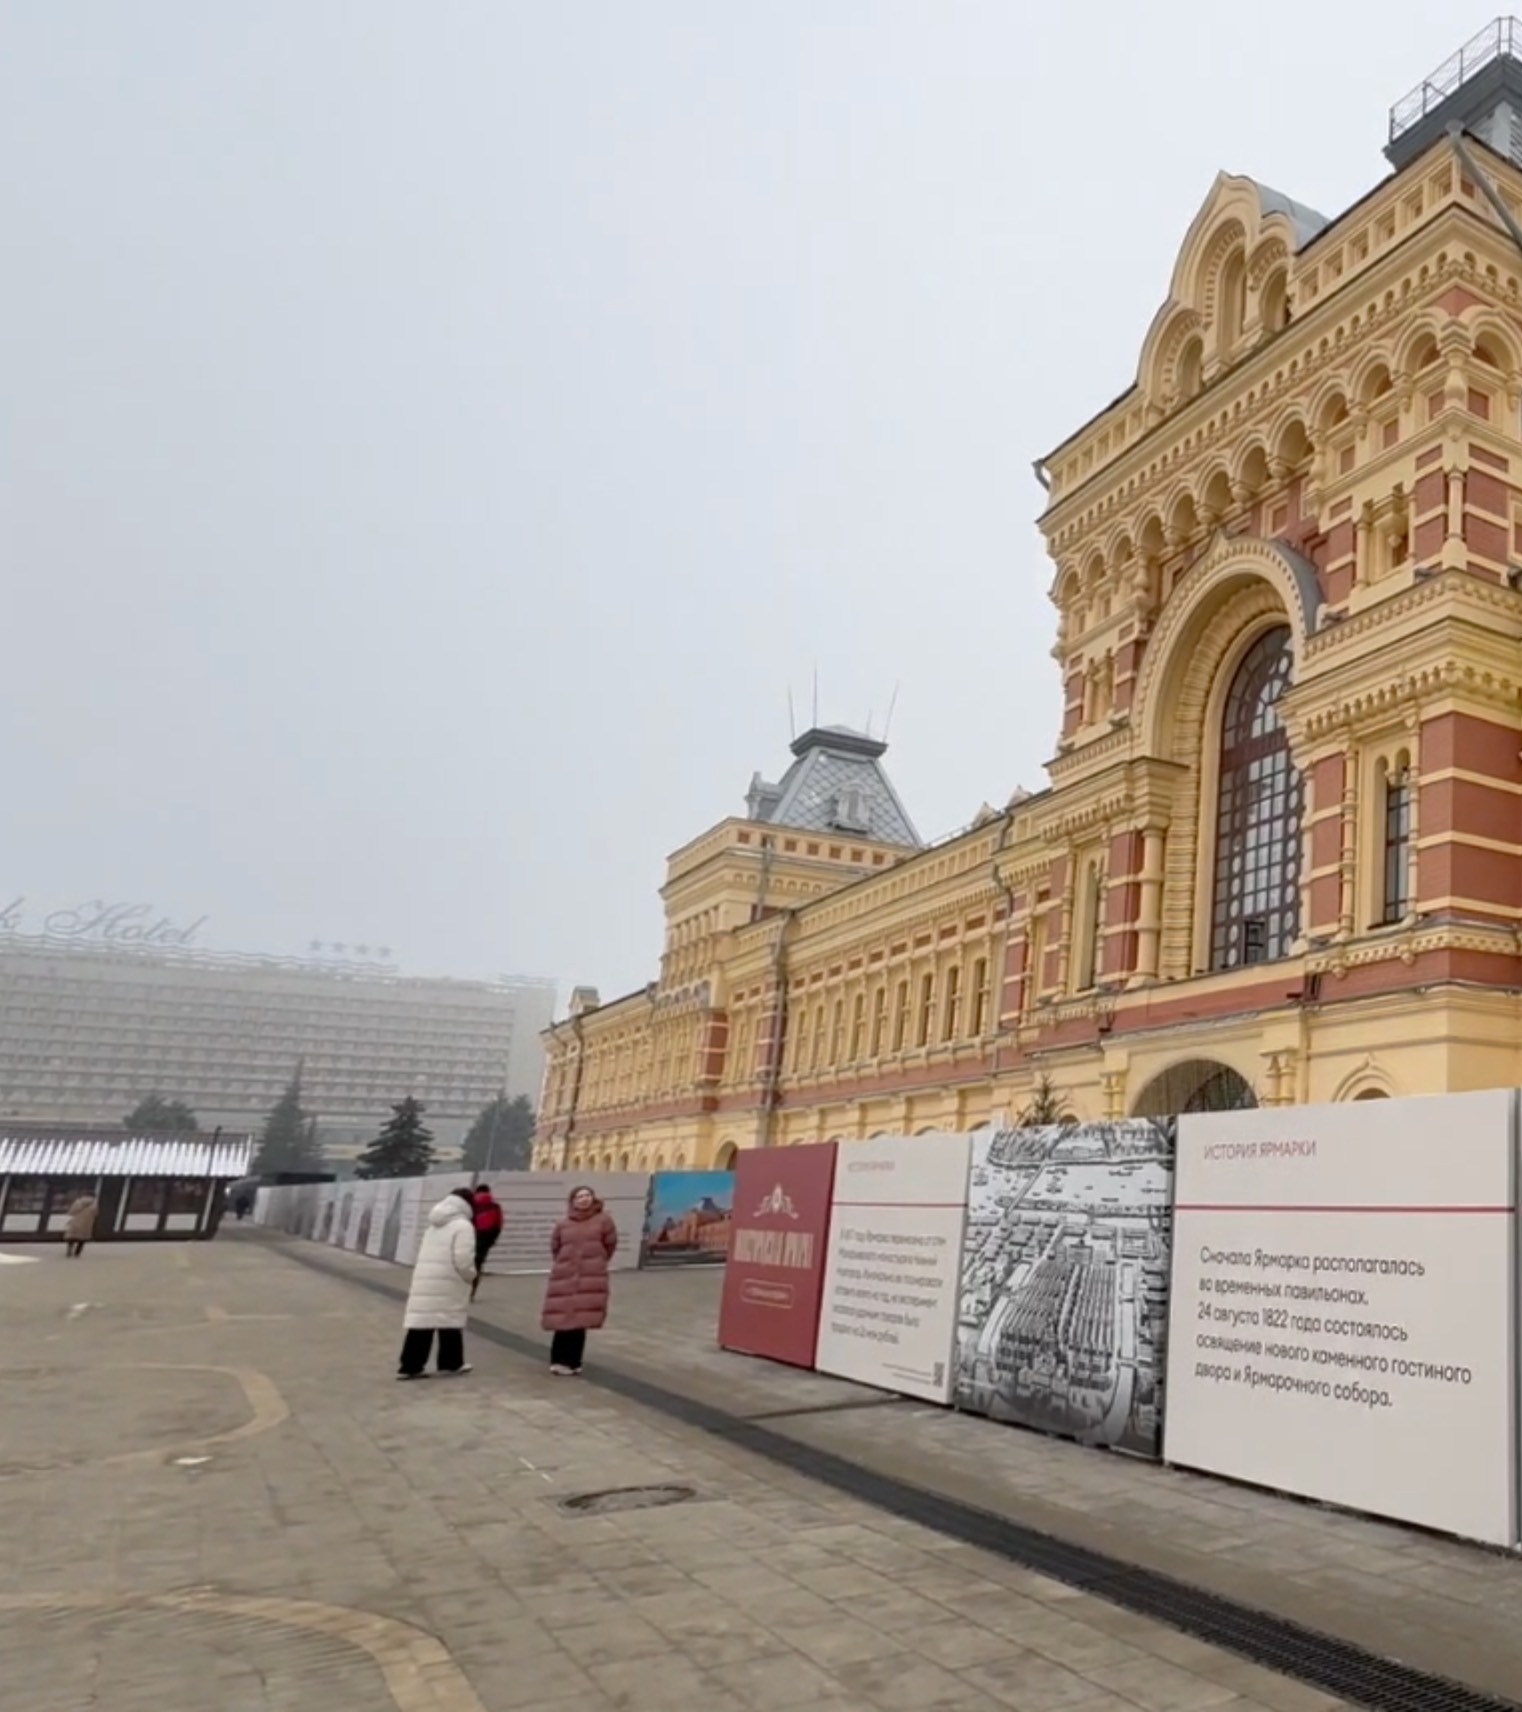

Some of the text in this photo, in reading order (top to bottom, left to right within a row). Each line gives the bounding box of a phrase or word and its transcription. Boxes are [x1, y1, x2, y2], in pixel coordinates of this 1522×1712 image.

[45, 899, 209, 944] Hotel
[1204, 1139, 1316, 1160] ИСТОРИЯ ЯРМАРКИ
[1200, 1246, 1425, 1277] Сначала Ярмарка располагалась
[1199, 1278, 1369, 1305] во временных павильонах.
[1198, 1302, 1408, 1342] 24 августа 1822 года состоялось
[1196, 1333, 1472, 1384] освящение нового каменного гостиного
[1195, 1362, 1393, 1409] двора и Ярмарочного собора.
